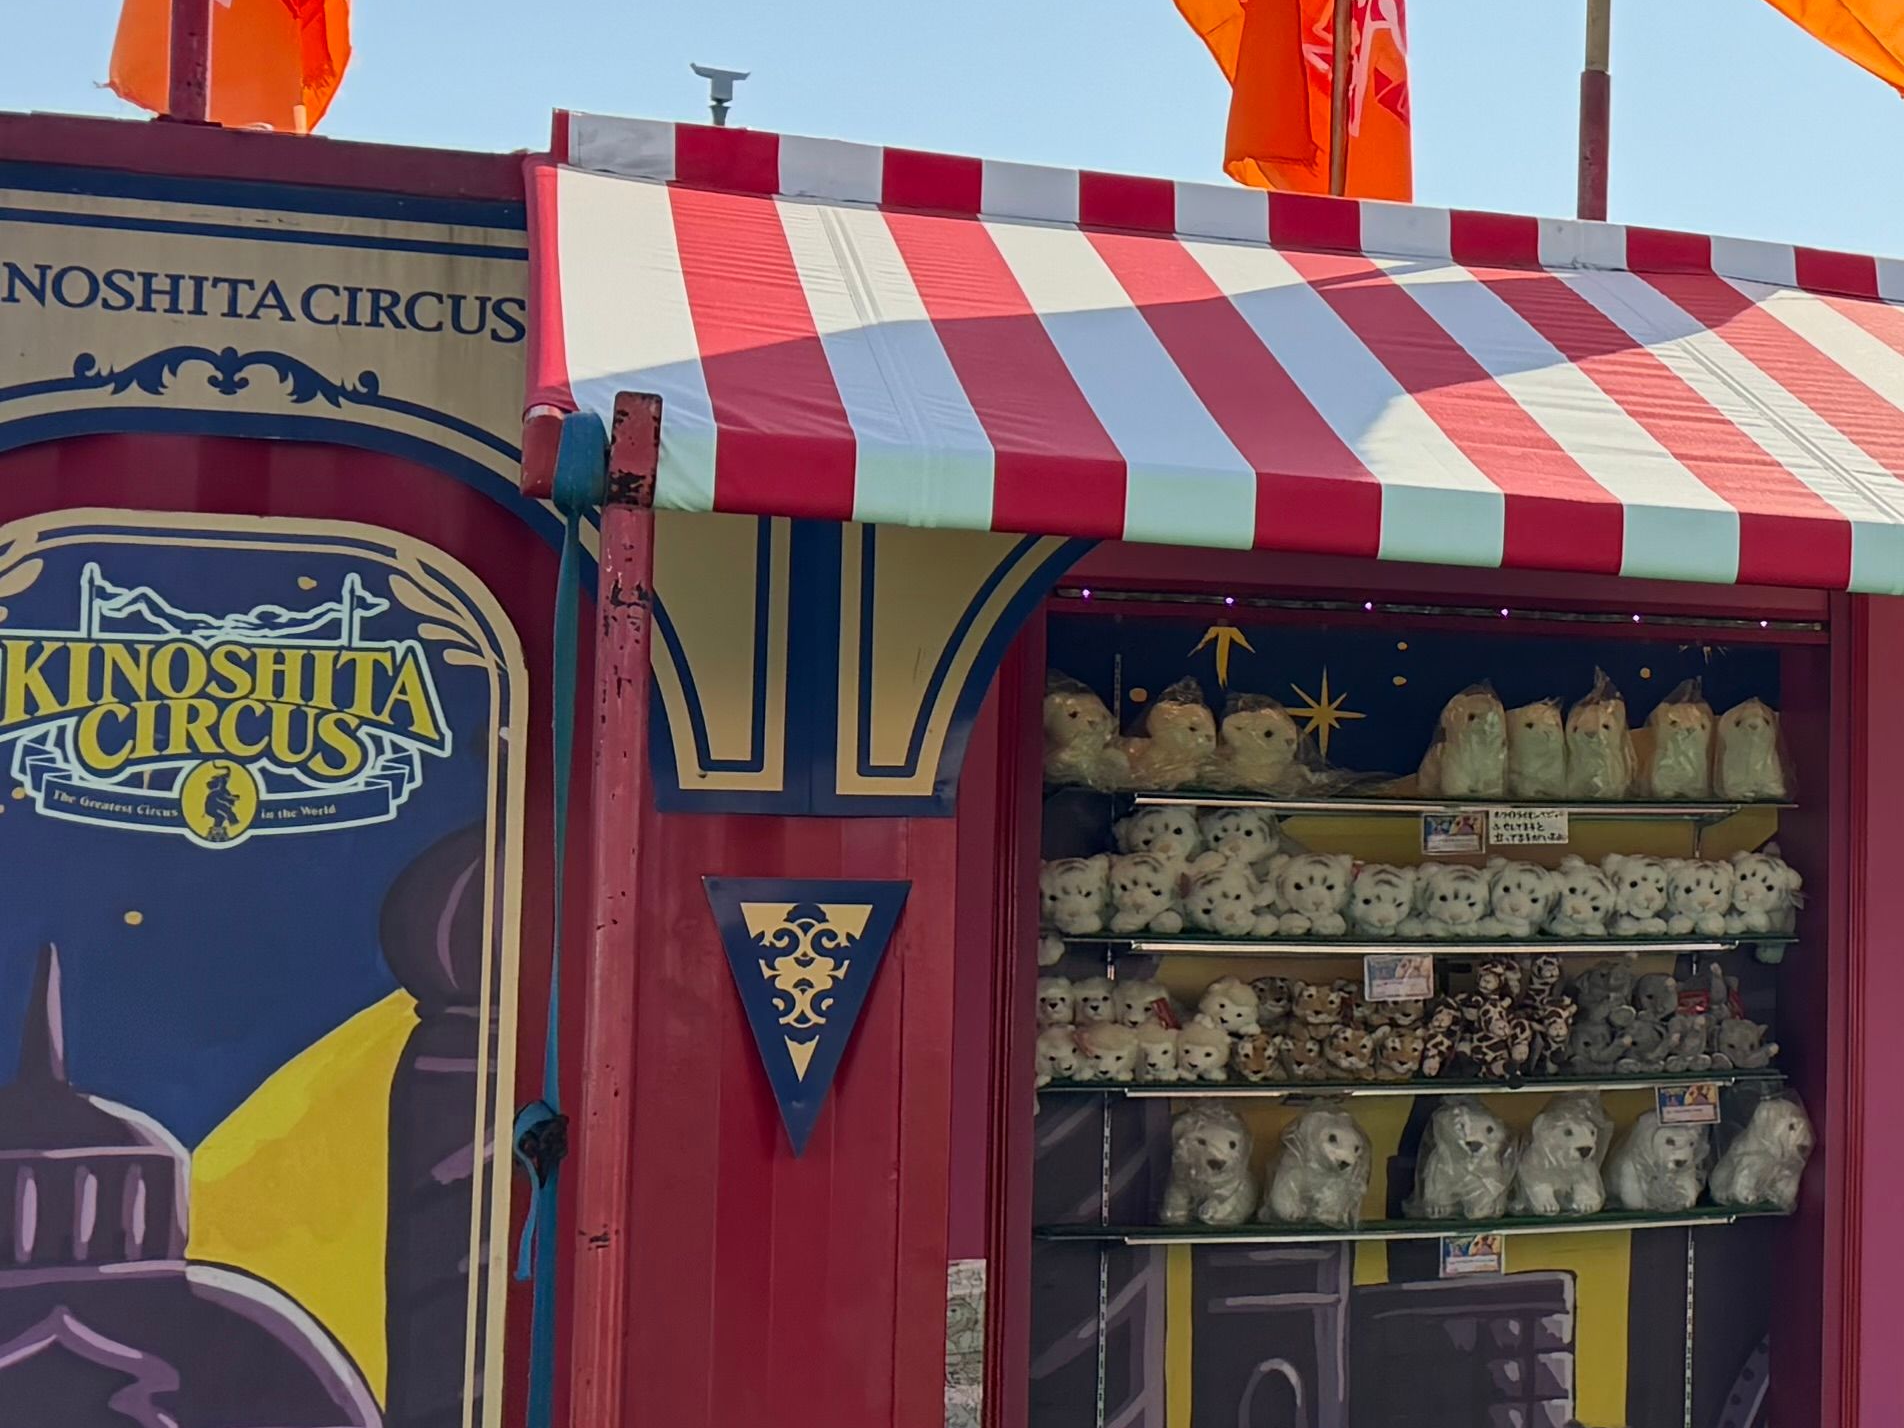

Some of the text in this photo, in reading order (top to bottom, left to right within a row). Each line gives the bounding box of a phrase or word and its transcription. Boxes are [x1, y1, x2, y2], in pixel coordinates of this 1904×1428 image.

[2, 640, 441, 741] KINOSHITA
[78, 698, 364, 778] CIRCUS
[52, 788, 179, 819] The Greatest Circus
[261, 804, 338, 820] in the World
